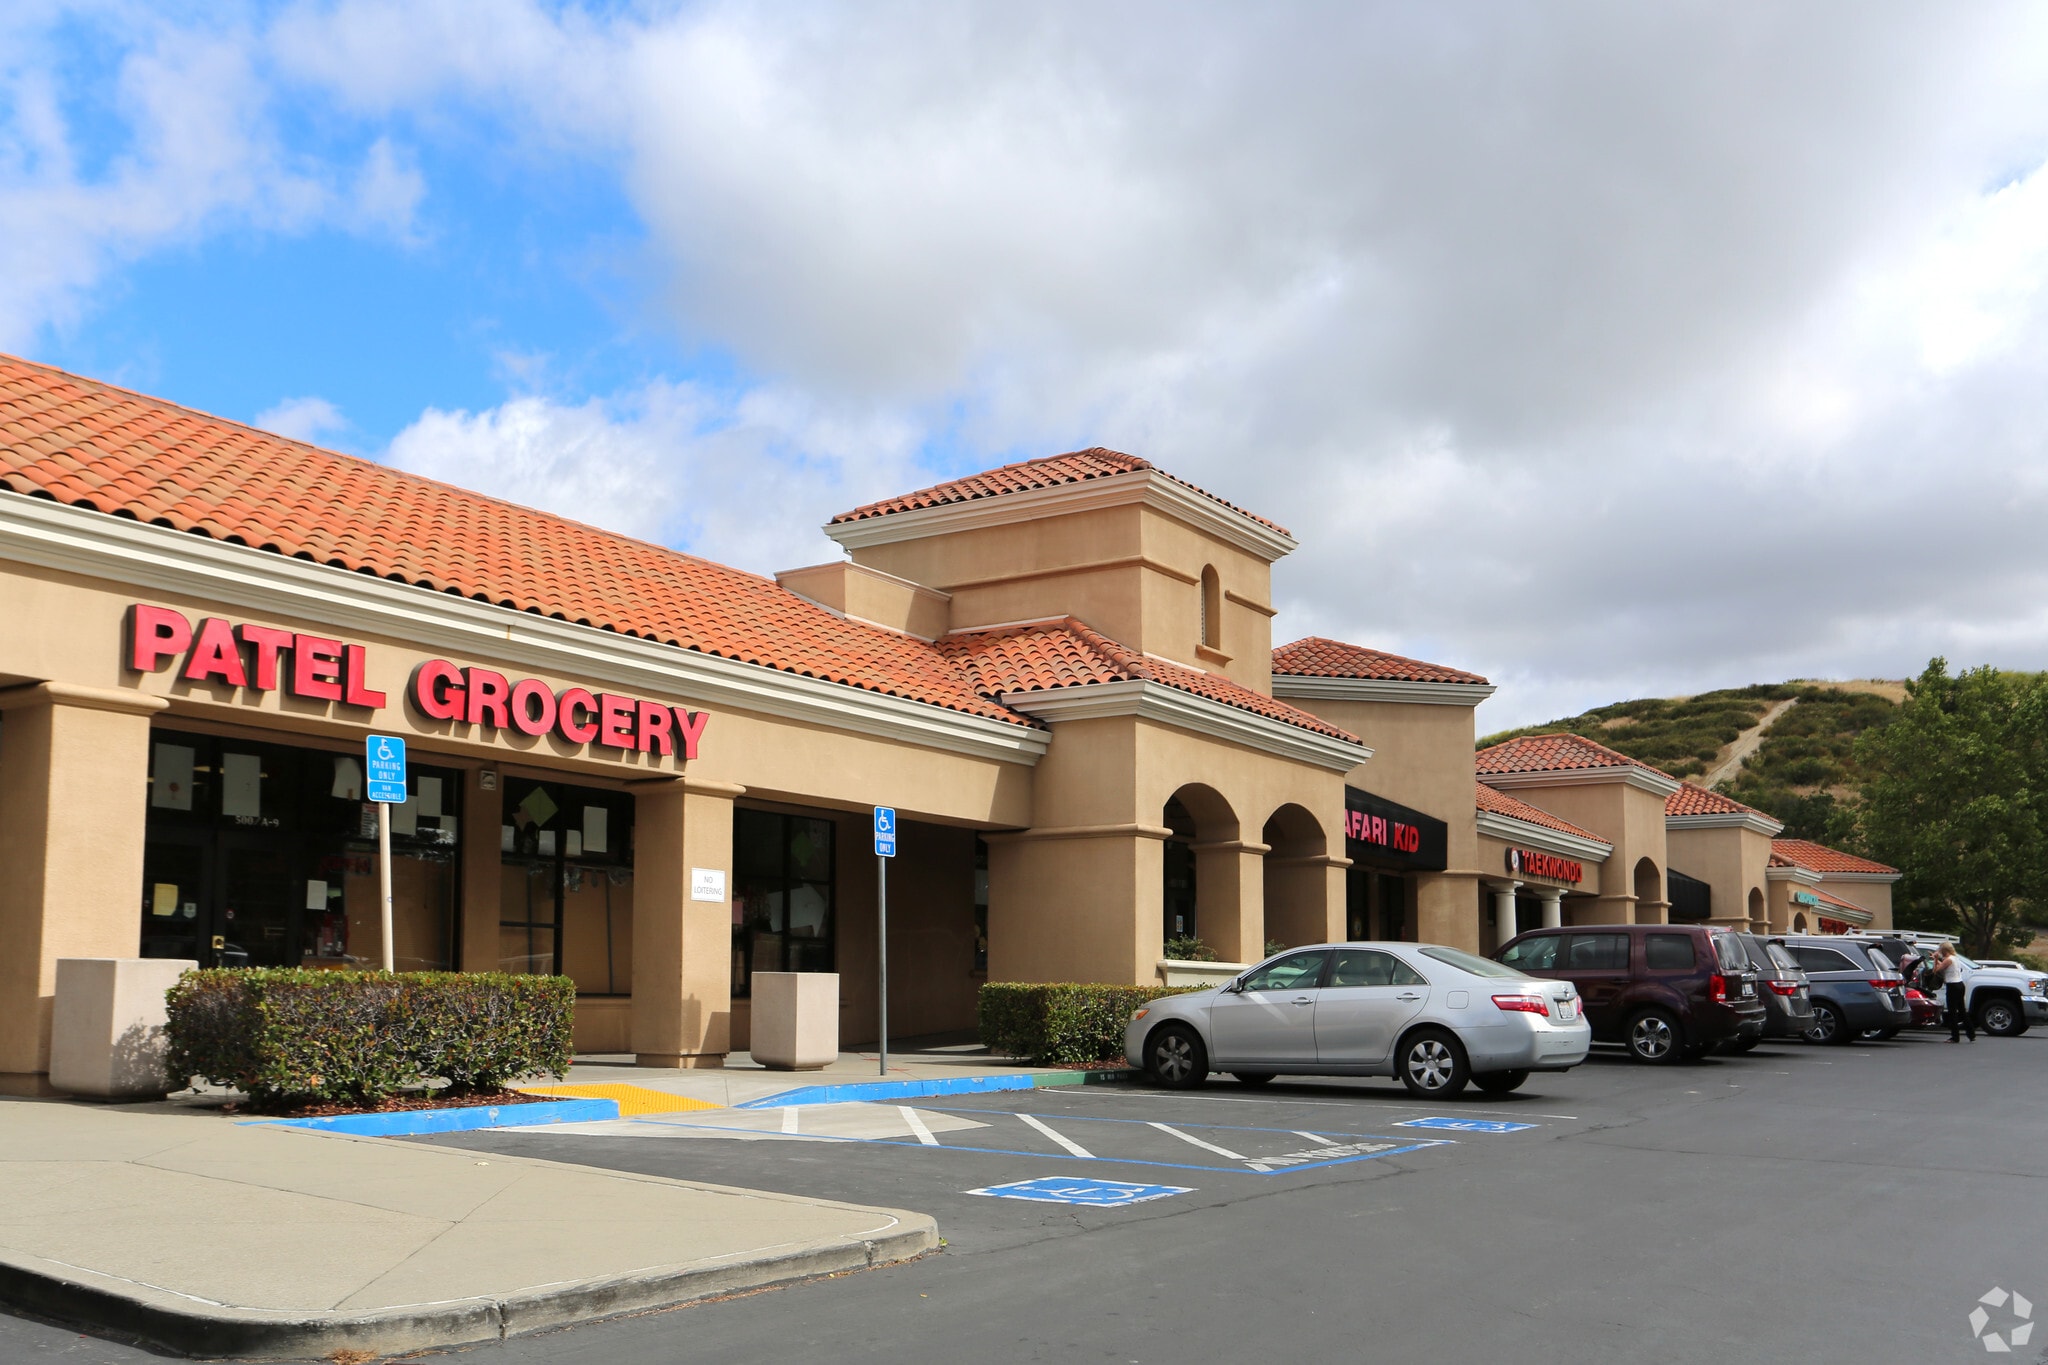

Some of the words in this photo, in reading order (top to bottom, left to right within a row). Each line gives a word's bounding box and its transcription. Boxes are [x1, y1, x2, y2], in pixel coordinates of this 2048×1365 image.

[129, 603, 387, 710] PATEL
[409, 659, 711, 760] GROCERY
[372, 760, 401, 771] PARKING
[378, 771, 395, 781] ONLY
[382, 784, 391, 792] VAN
[371, 791, 402, 801] ACCESSIBLE
[875, 831, 895, 843] PARKING
[1393, 822, 1419, 853] KID
[879, 842, 891, 853] ONLY
[1522, 850, 1582, 883] TAEKWONDO
[703, 876, 713, 884] NO
[693, 885, 723, 896] LOITERING
